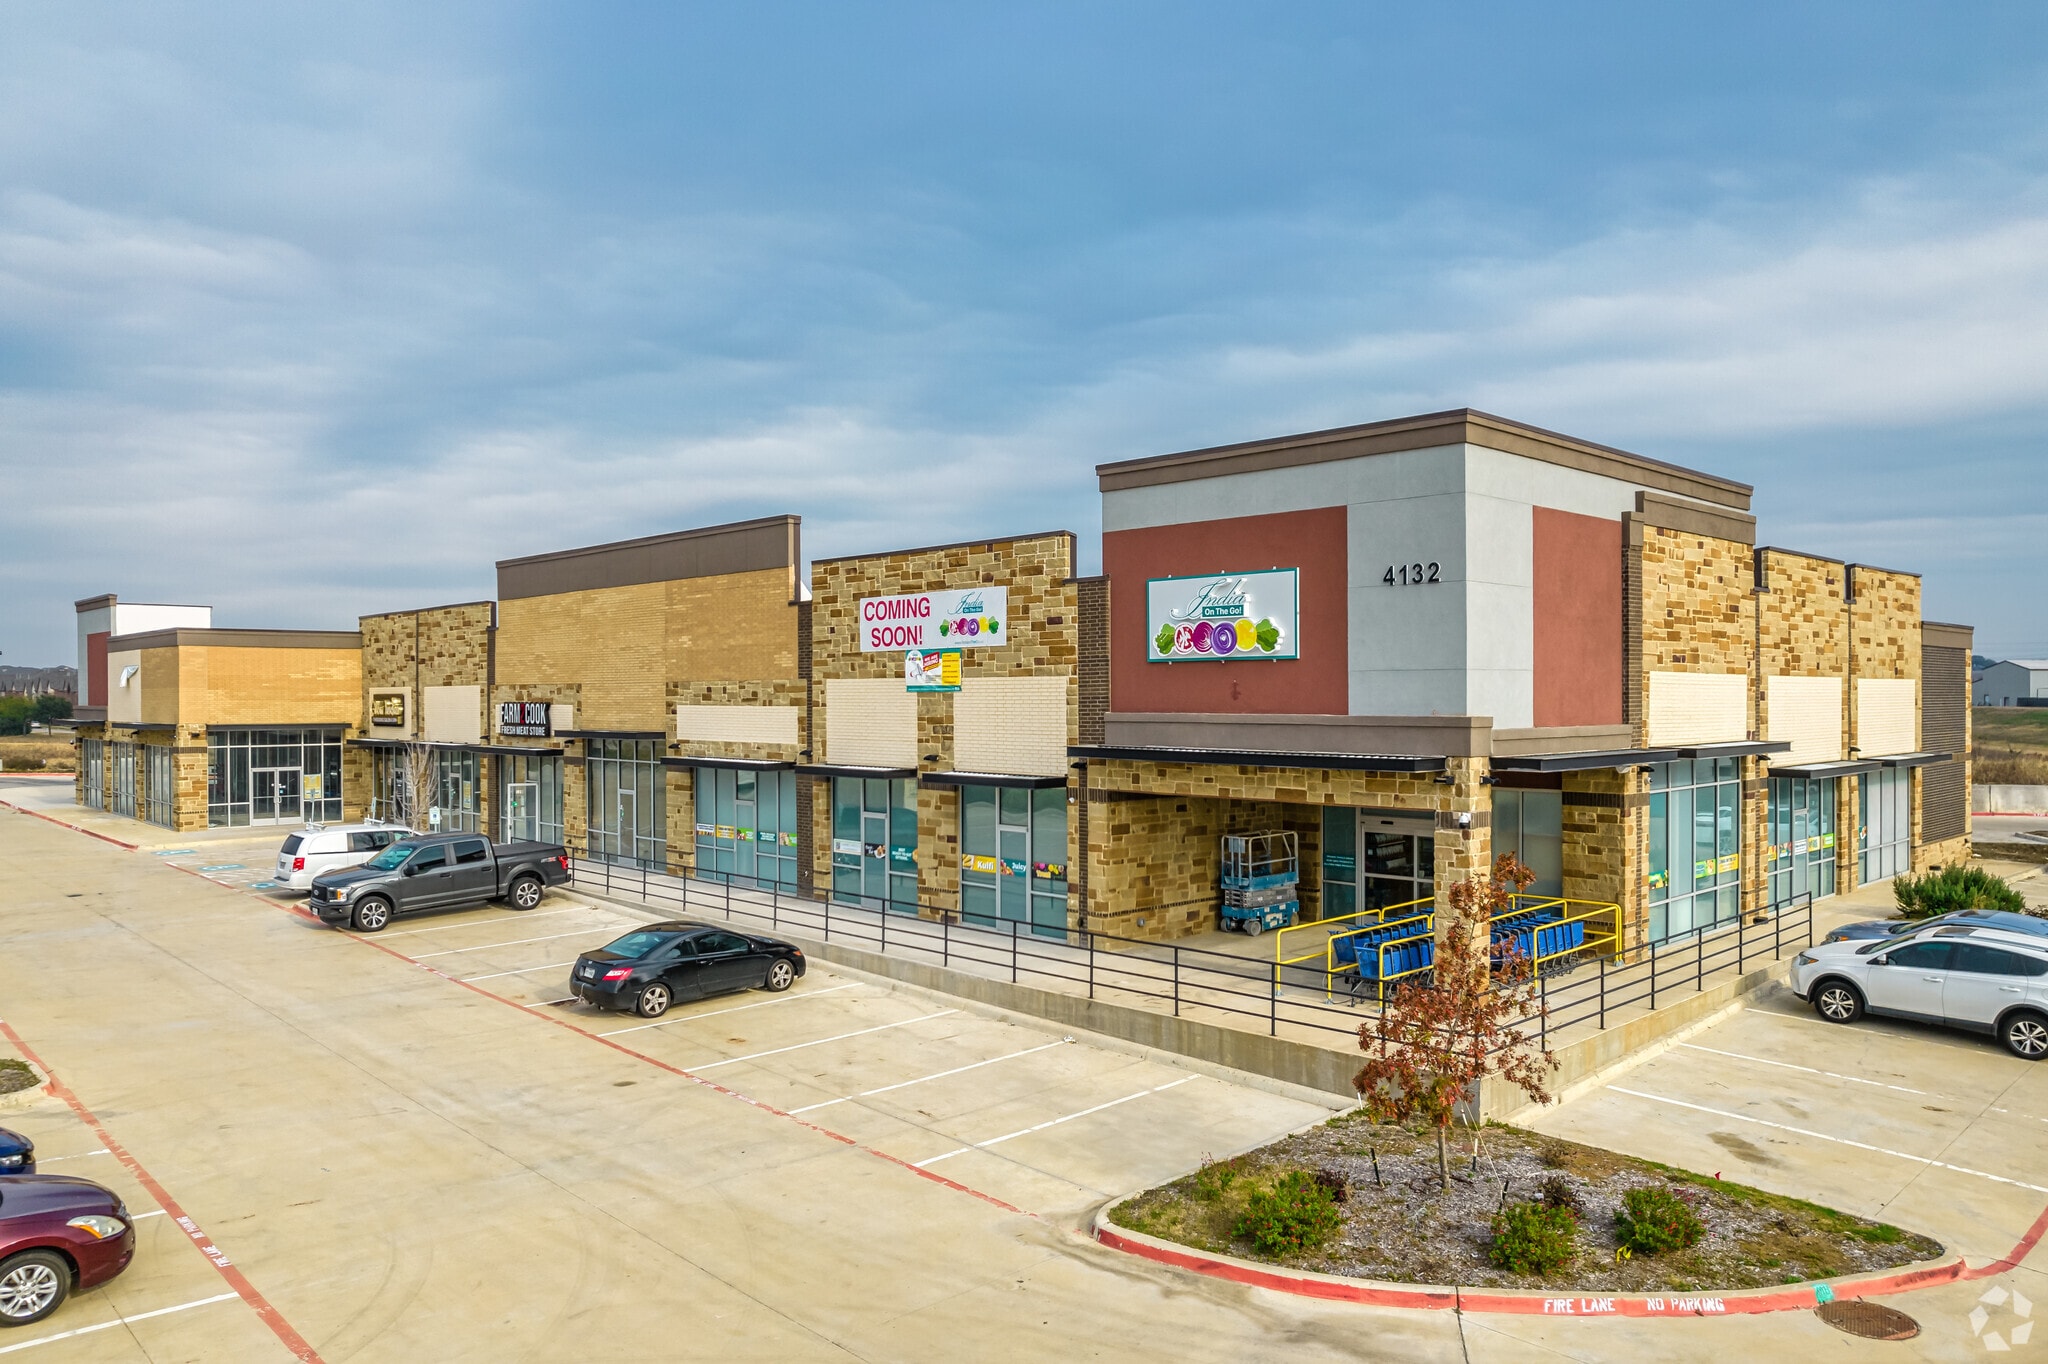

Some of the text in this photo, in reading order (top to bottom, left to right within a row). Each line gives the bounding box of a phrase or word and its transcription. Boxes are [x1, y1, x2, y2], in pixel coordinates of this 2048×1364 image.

[1383, 561, 1442, 586] 4132
[947, 591, 984, 615] India
[1169, 577, 1246, 620] India
[864, 596, 931, 622] COMING
[1204, 606, 1242, 616] On The Go!
[871, 625, 923, 648] SOON!
[501, 725, 545, 736] FRESH MEAT STORE
[977, 860, 994, 870] Kulfi
[1012, 862, 1027, 872] Juicy
[1544, 1297, 1726, 1313] FIRE LANE NO PARKING
